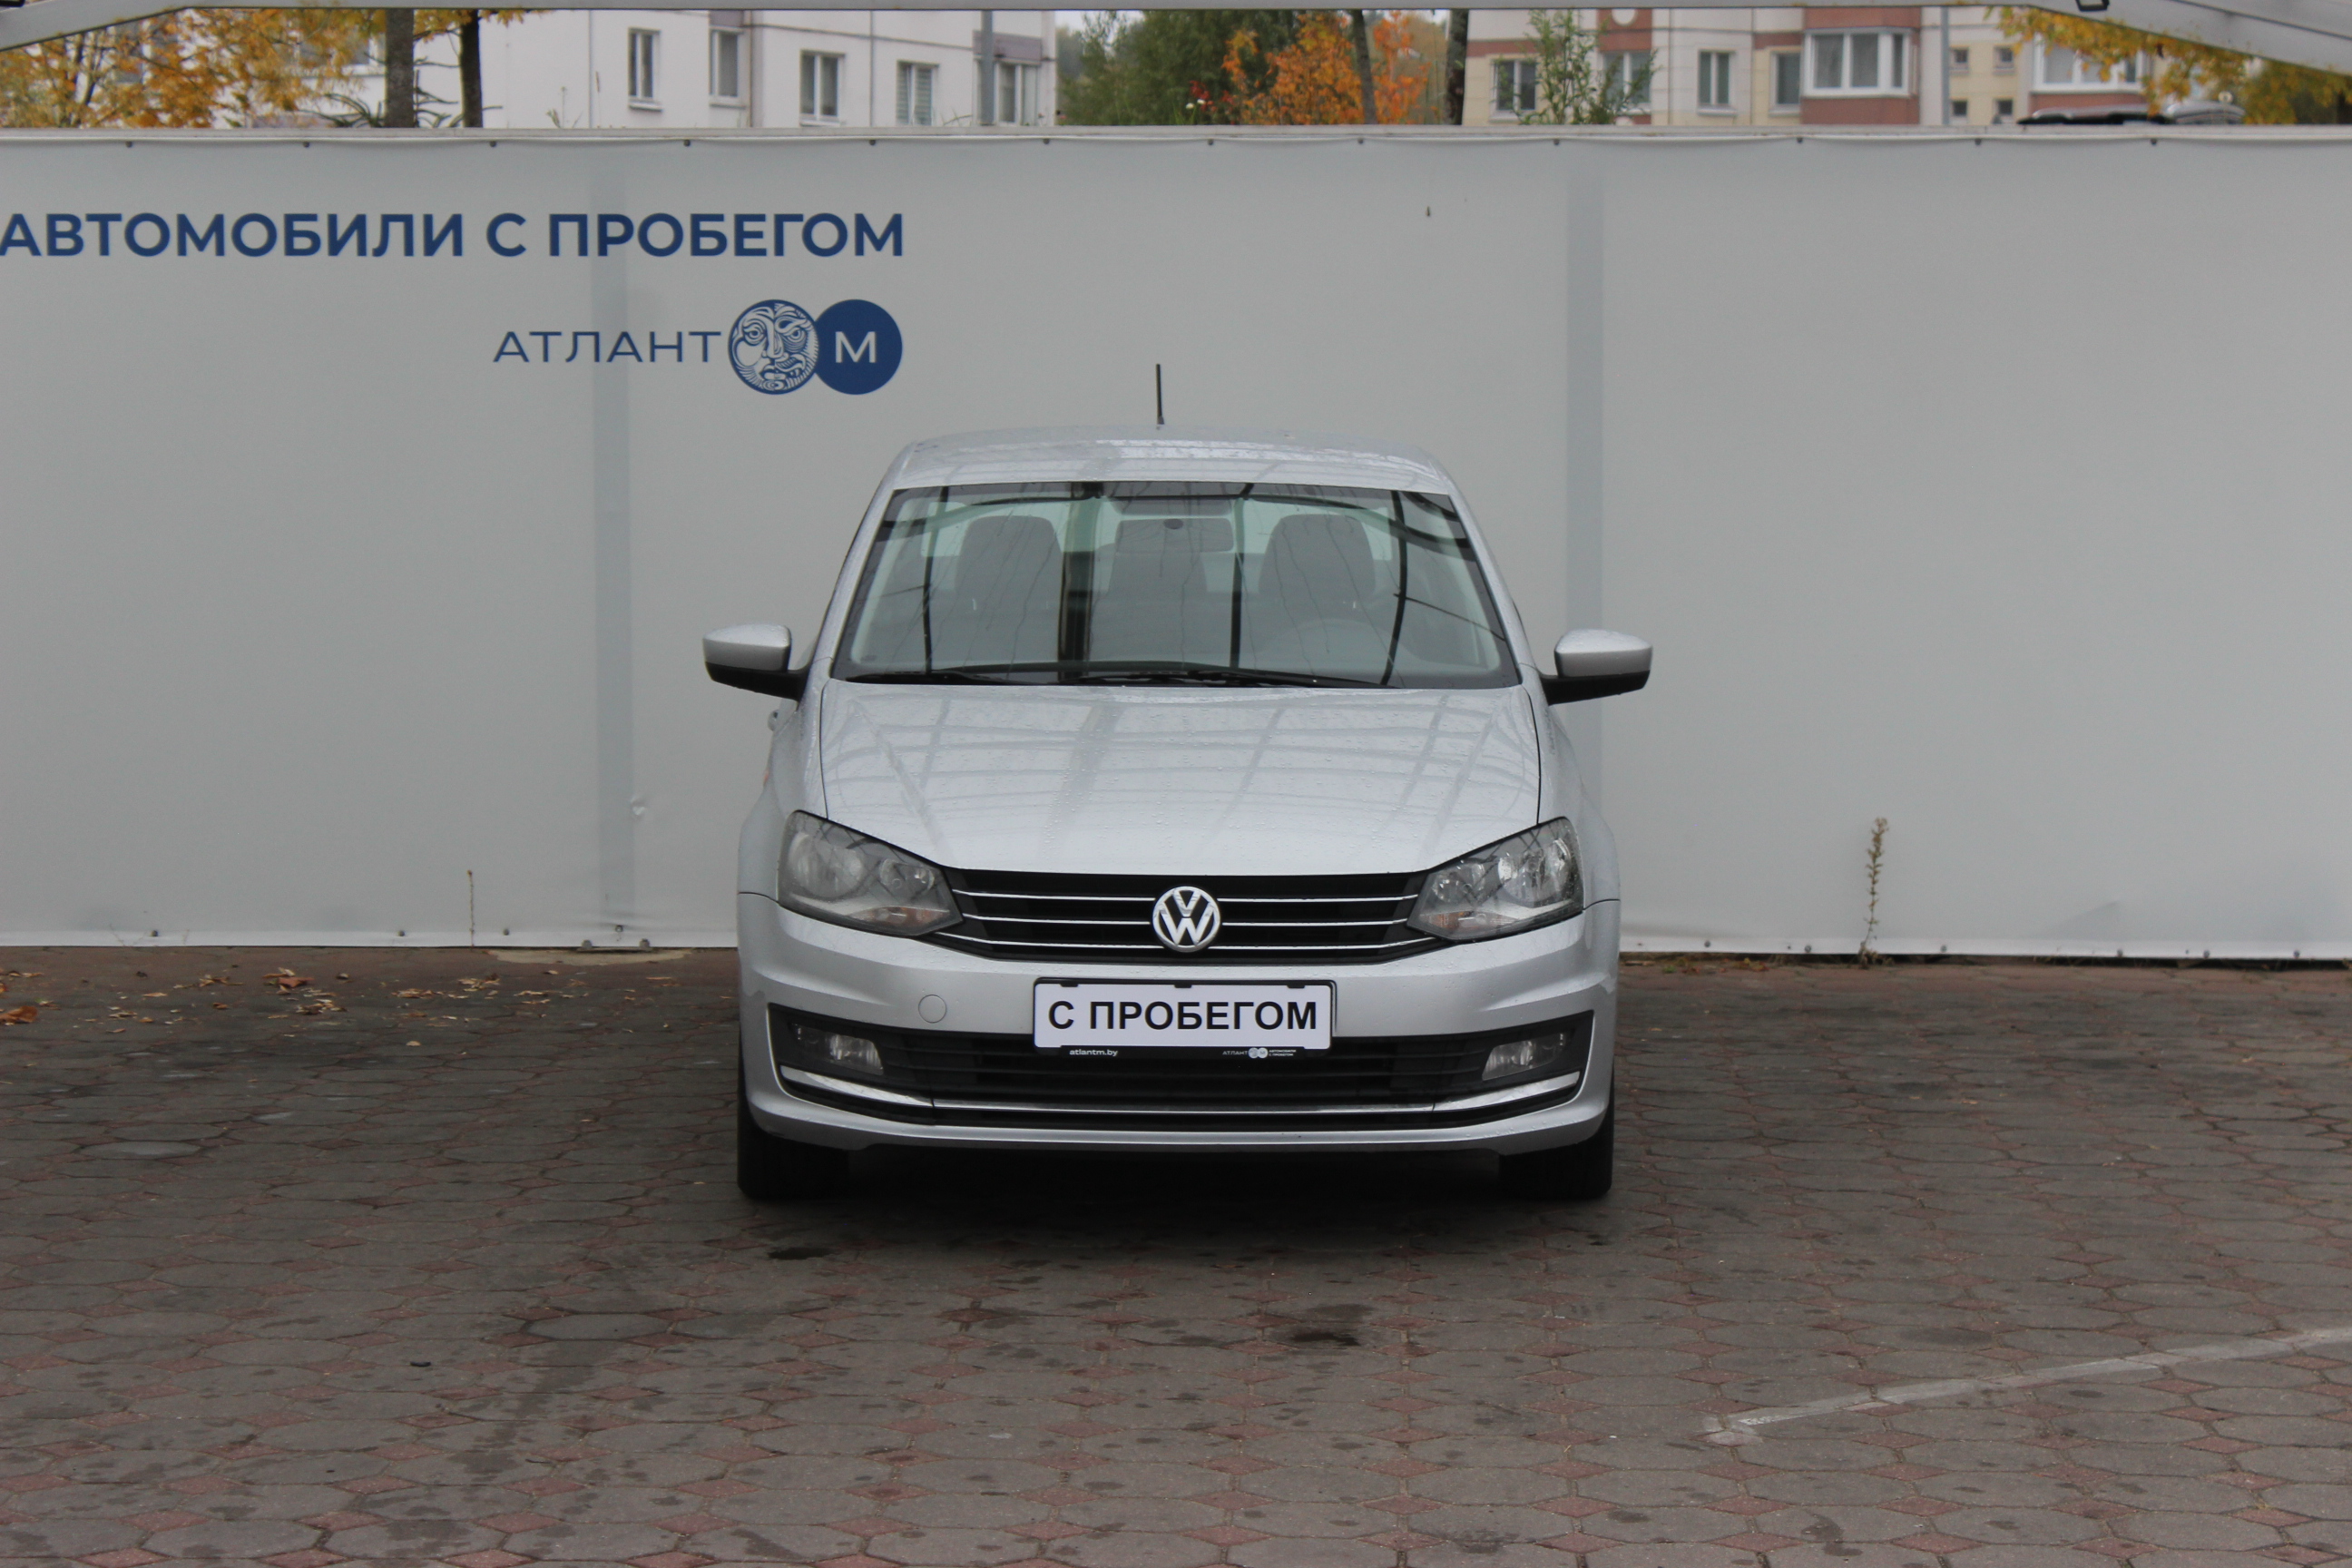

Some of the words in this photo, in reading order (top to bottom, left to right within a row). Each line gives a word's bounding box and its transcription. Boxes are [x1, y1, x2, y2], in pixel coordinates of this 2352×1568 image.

[0, 213, 465, 258] АВТОМОБИЛИ
[487, 213, 527, 258] С
[551, 213, 904, 258] ПРОБЕГОМ
[493, 331, 722, 363] АТЛАНТ
[1048, 1001, 1074, 1030] С
[1090, 1001, 1317, 1030] ПРОБЕГОМ
